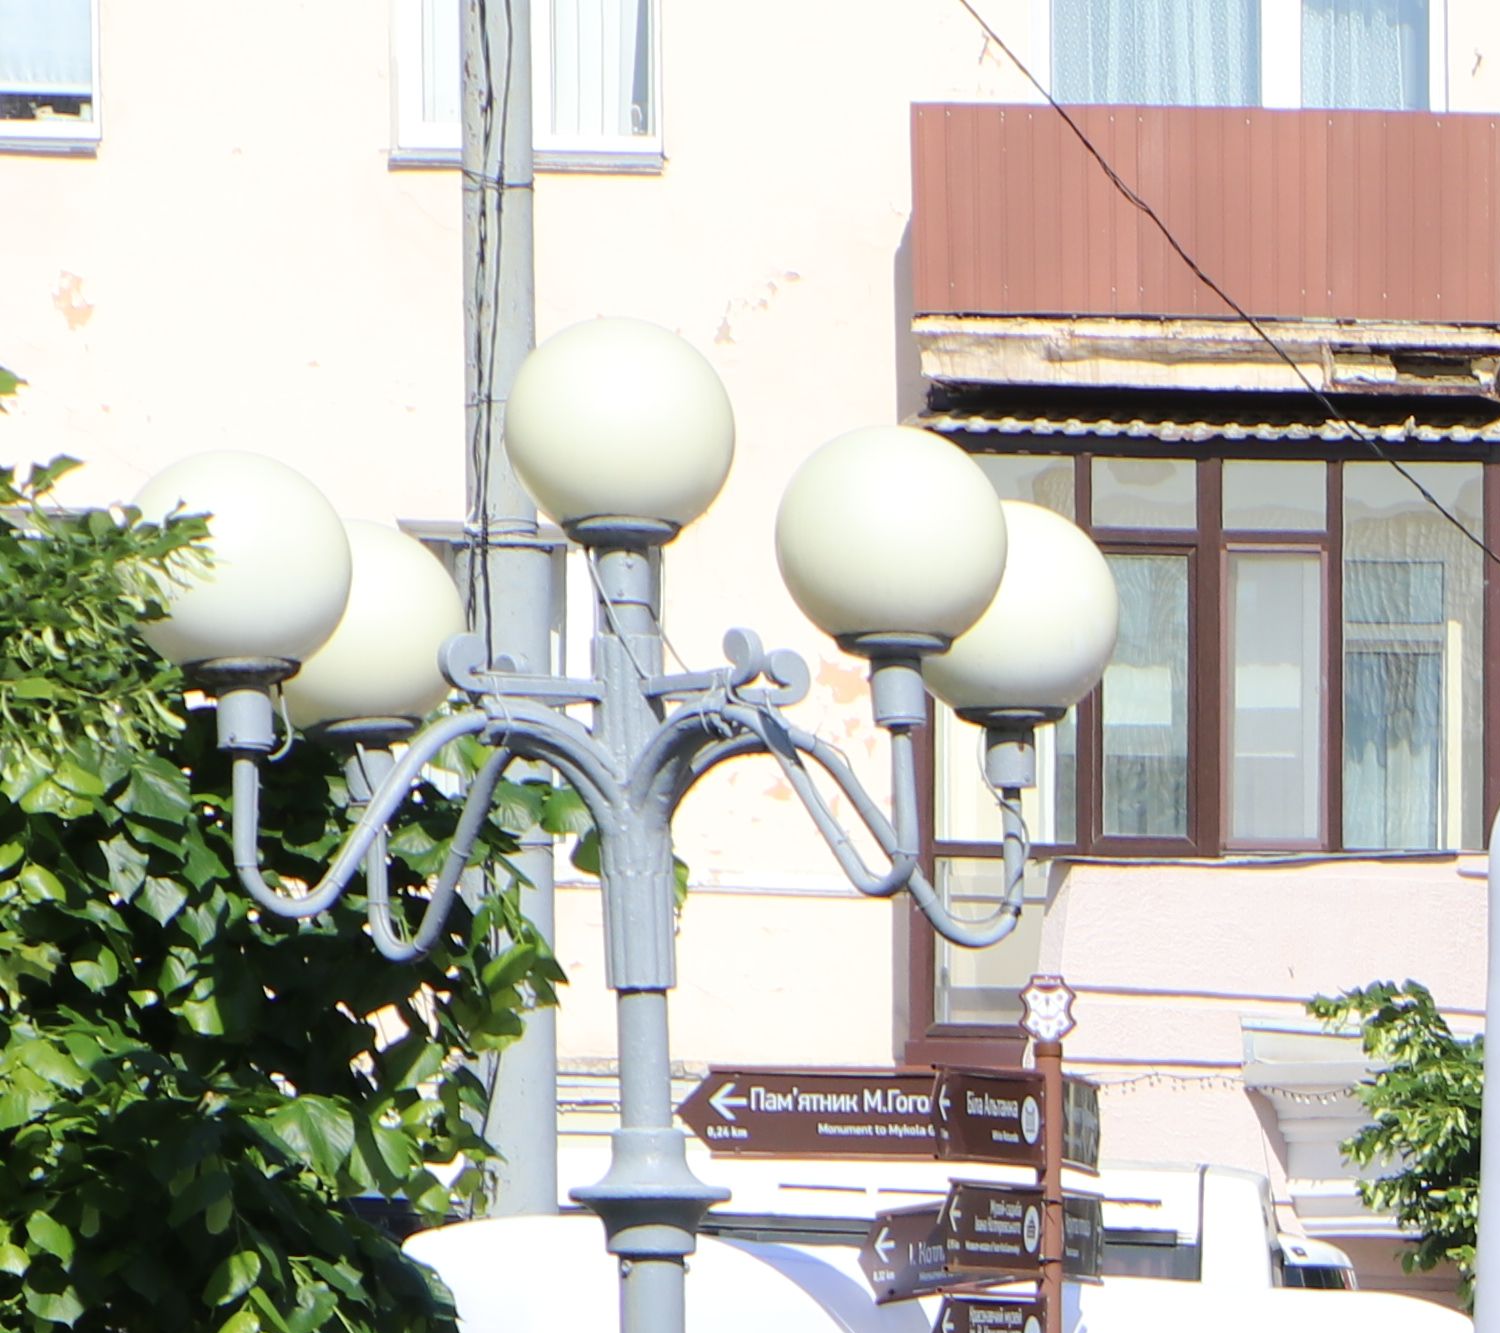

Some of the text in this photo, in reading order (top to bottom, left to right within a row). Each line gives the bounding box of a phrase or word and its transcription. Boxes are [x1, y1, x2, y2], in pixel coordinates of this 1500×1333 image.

[750, 1086, 932, 1114] Пам'ятник М.Гого
[706, 1125, 749, 1139] 0,24 km
[818, 1123, 873, 1136] Monument
[875, 1124, 886, 1136] to
[888, 1123, 926, 1139] Mykola
